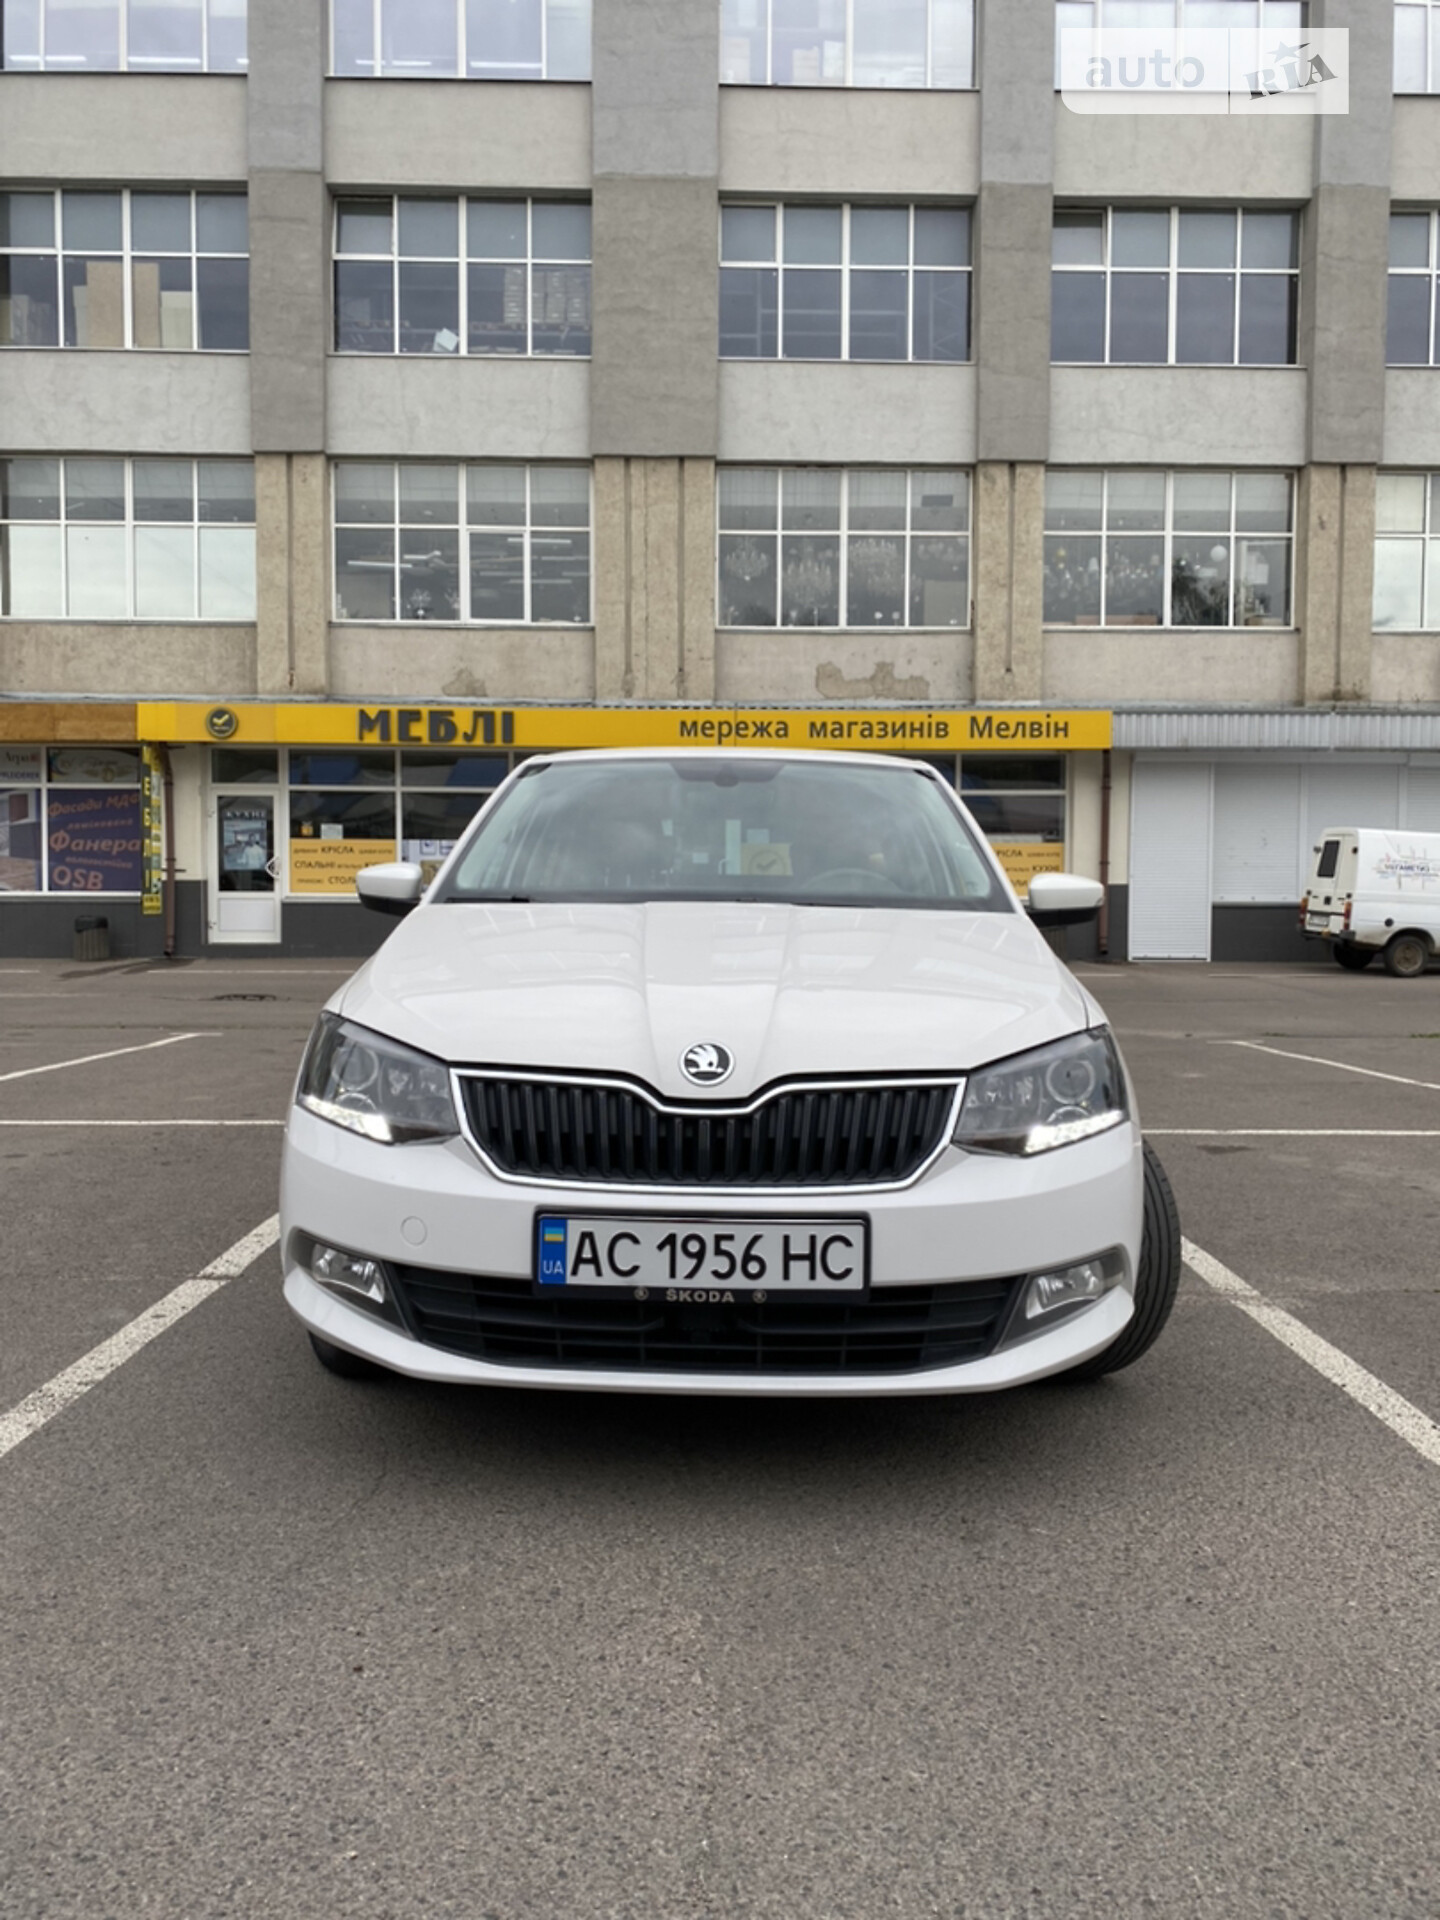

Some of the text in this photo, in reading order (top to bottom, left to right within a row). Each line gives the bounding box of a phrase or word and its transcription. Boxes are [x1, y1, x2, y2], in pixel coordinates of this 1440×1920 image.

[358, 708, 515, 744] МЕБЛІ
[679, 713, 1070, 745] мережа магазинів Мелвін
[50, 829, 141, 856] Фанера
[322, 846, 354, 854] КРІСЛА
[52, 865, 104, 890] OSB
[543, 1259, 565, 1276] UA
[570, 1231, 854, 1281] AC 1956 HC
[666, 1287, 735, 1303] ŠKODA
